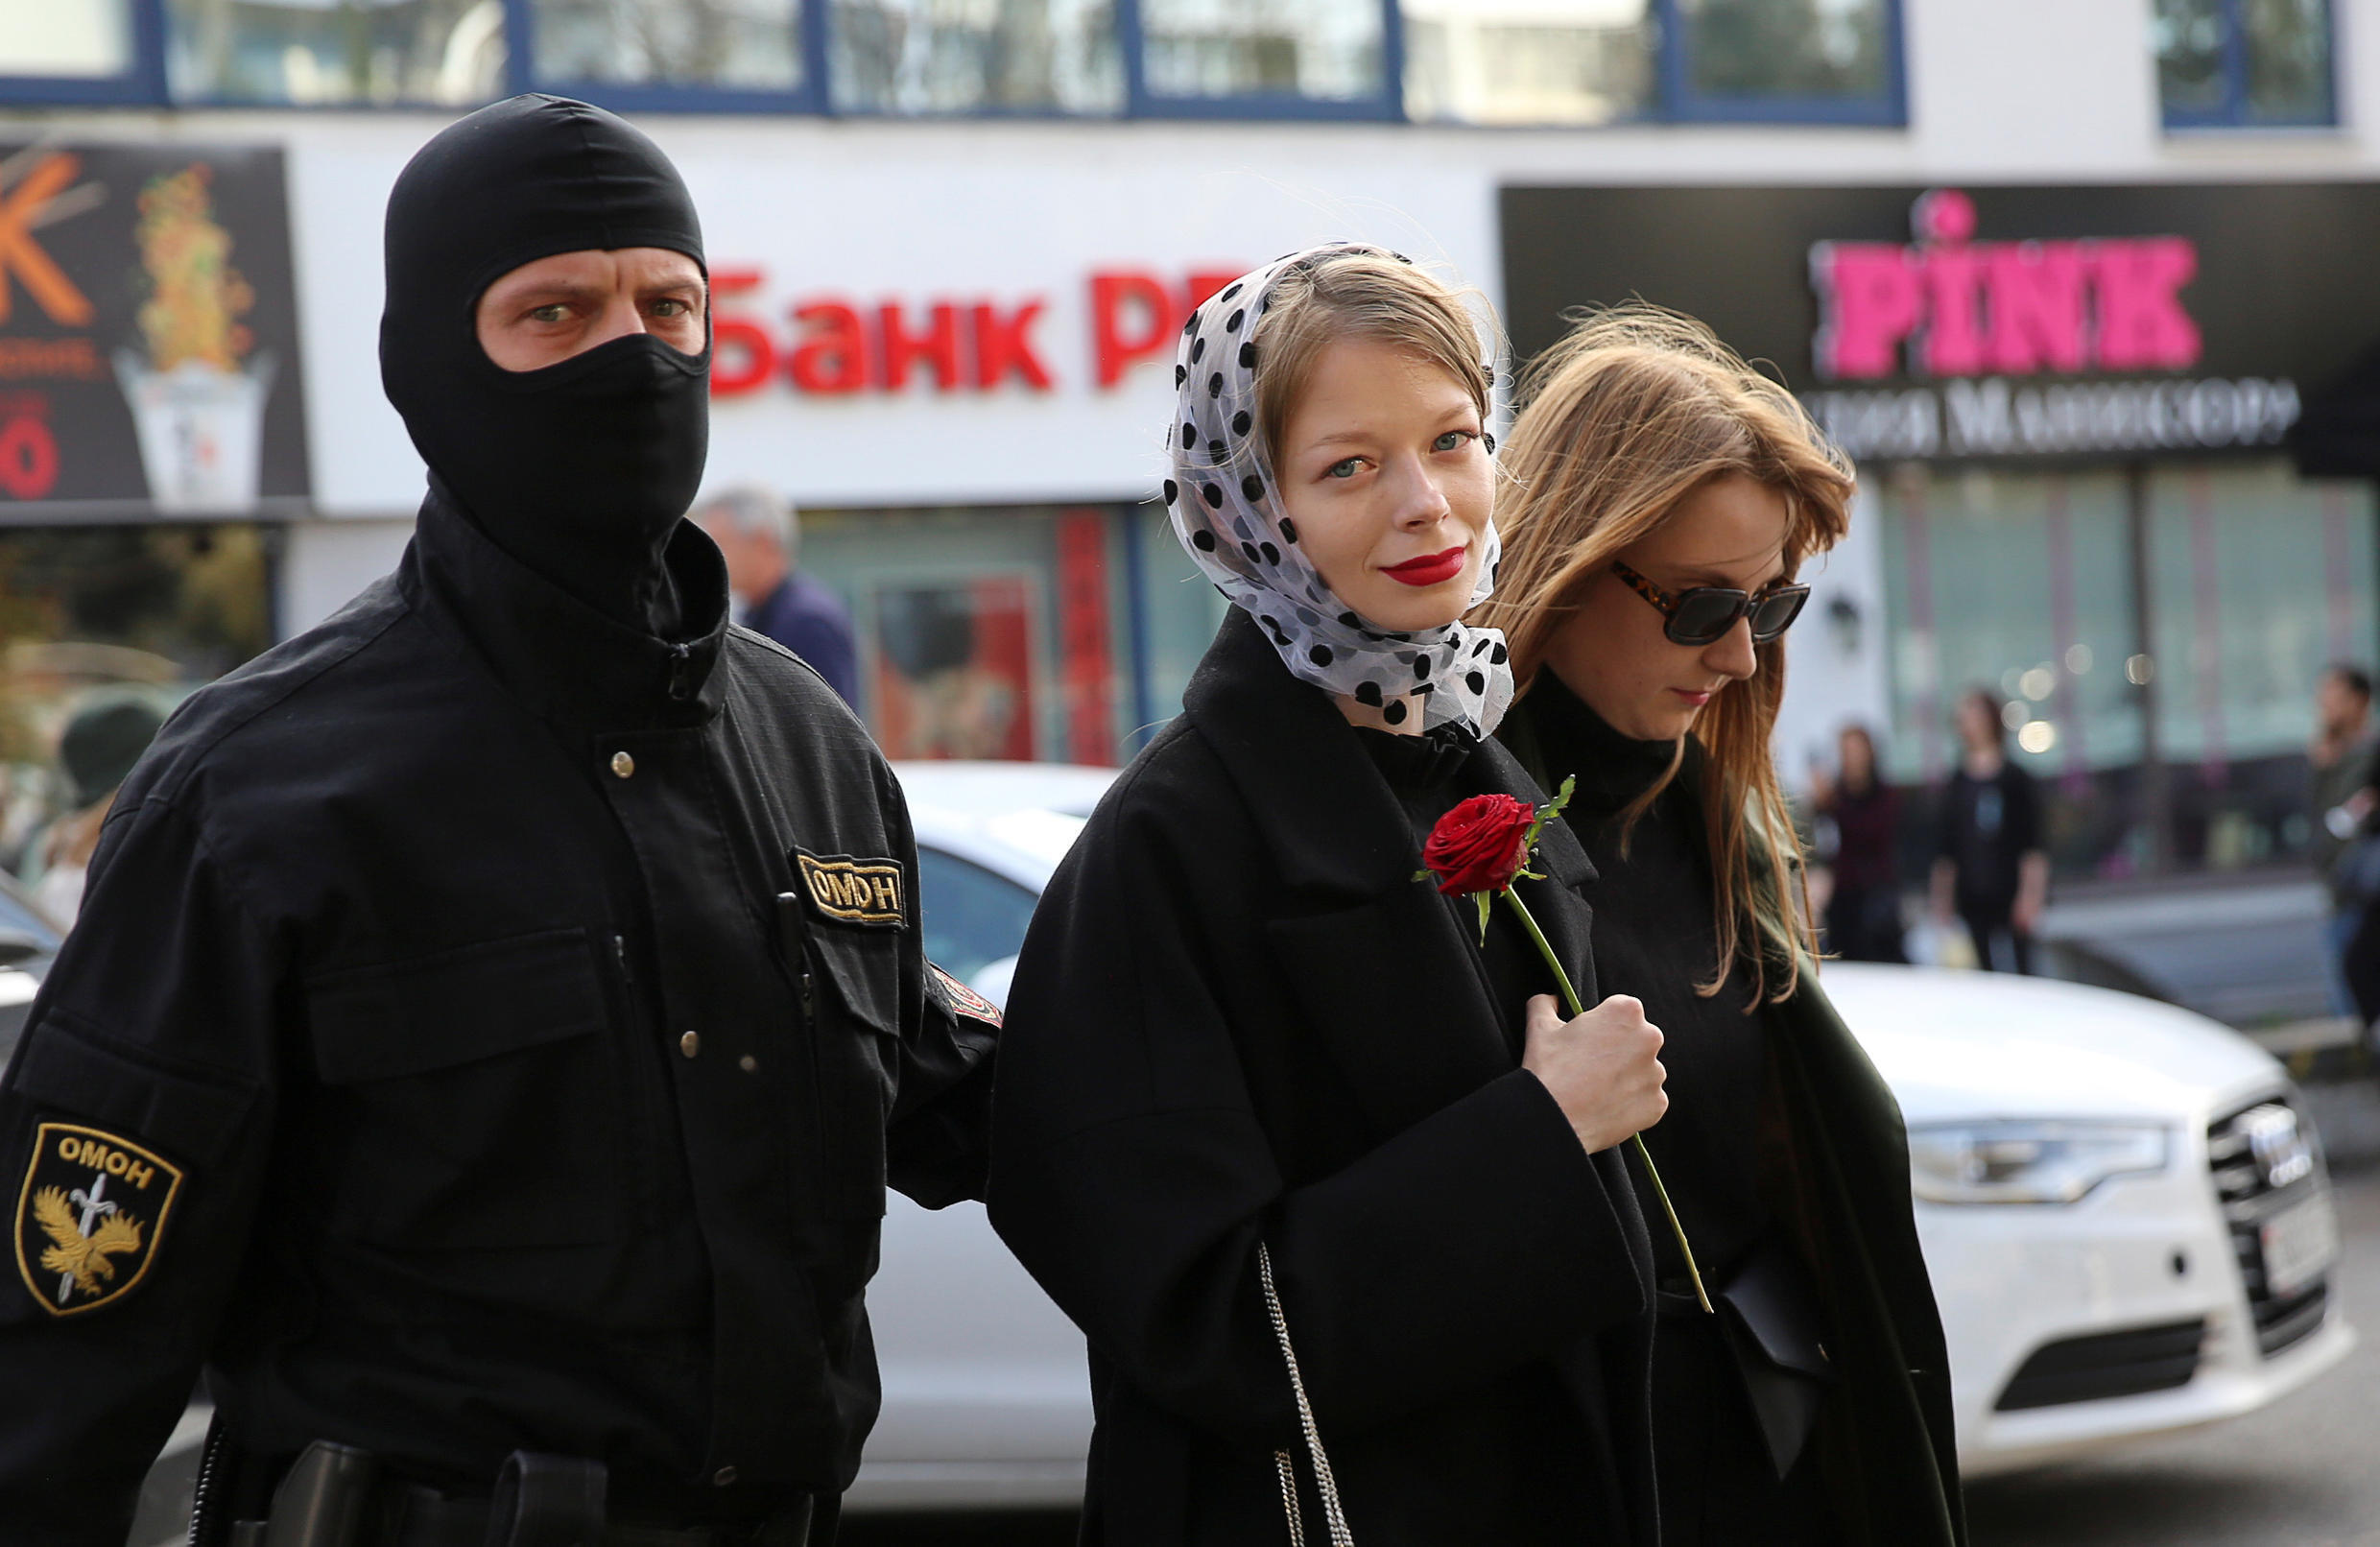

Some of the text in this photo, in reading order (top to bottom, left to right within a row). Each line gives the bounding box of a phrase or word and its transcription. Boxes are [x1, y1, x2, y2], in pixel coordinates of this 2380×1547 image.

[708, 266, 1056, 399] Банк
[813, 869, 898, 911] ОМОН
[59, 1137, 155, 1189] ОМОН
